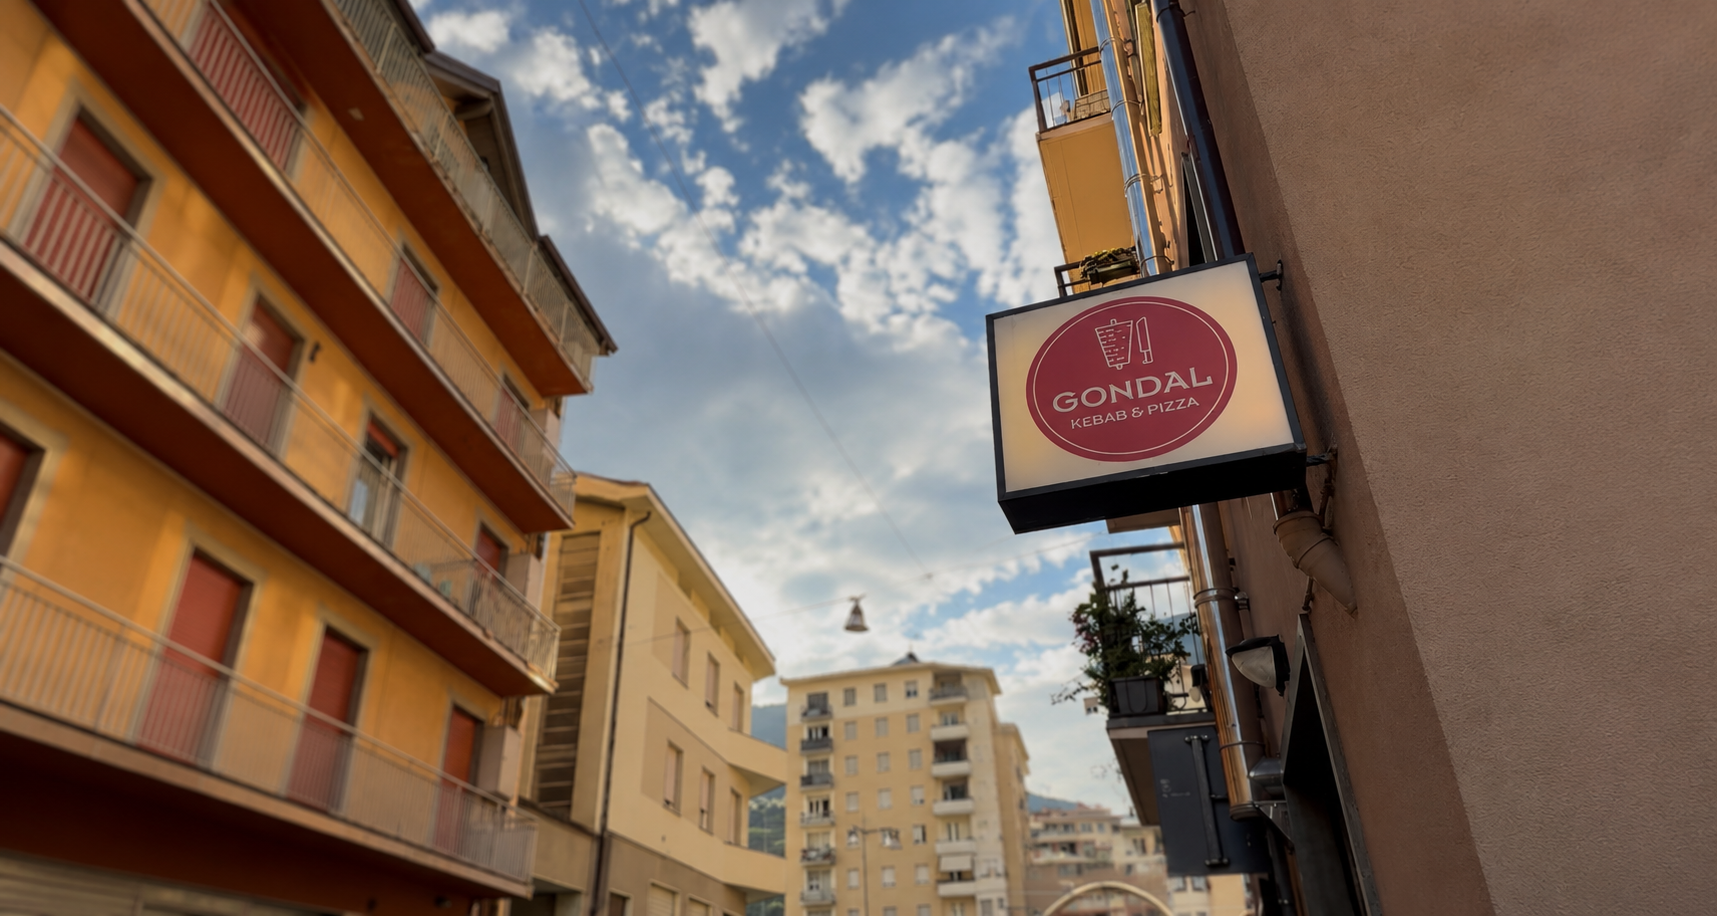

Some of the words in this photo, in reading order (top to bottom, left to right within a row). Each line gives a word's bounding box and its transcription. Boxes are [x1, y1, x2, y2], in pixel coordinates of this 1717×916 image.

[1052, 367, 1213, 412] GONDAL
[1071, 410, 1127, 429] KEBAB
[1131, 407, 1144, 418] &
[1149, 397, 1199, 415] PIZZA
